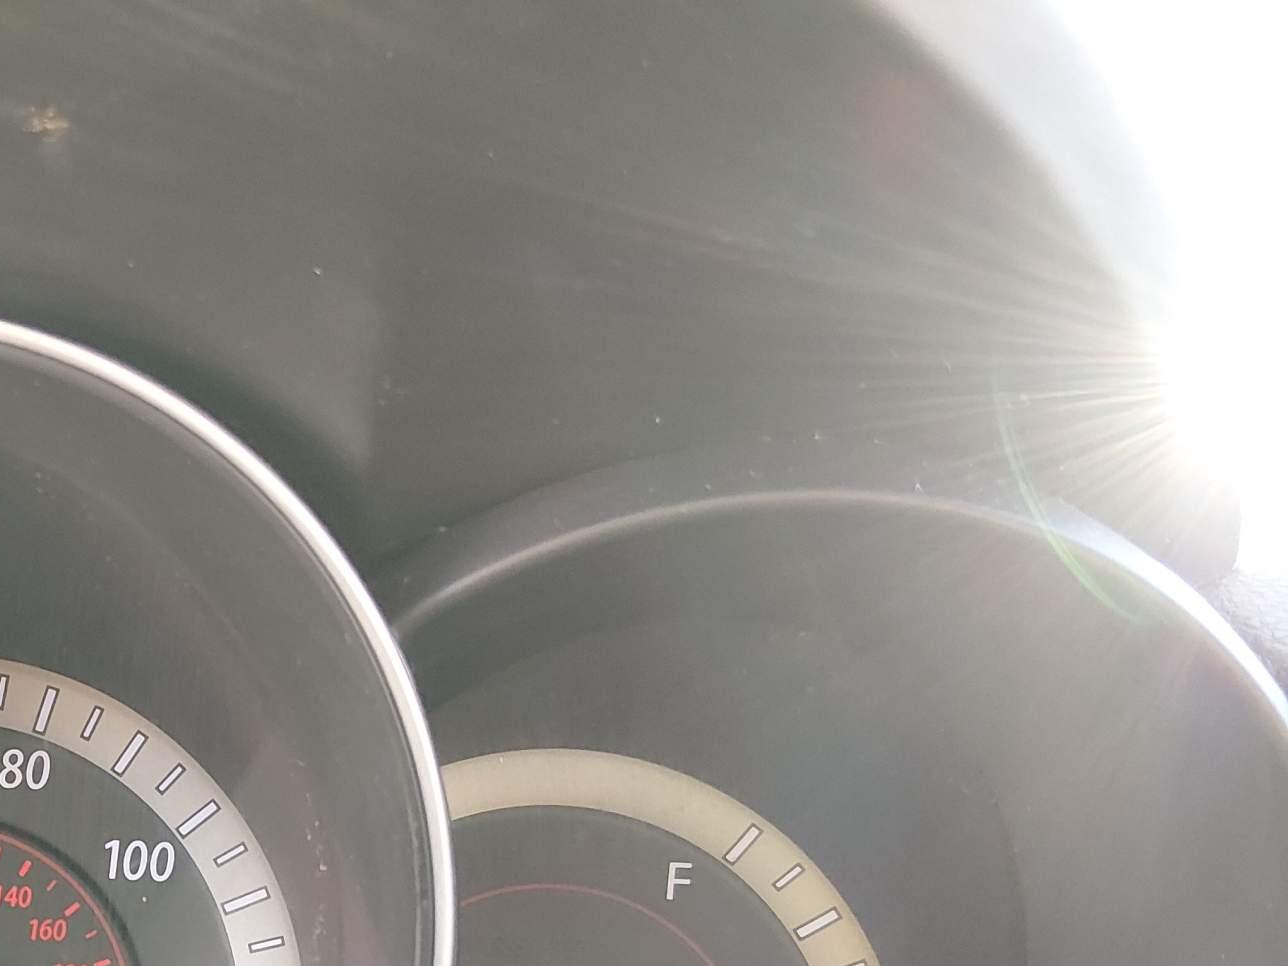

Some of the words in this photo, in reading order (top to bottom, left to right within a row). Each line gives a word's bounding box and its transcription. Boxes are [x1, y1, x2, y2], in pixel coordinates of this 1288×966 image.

[104, 840, 175, 882] 100
[666, 862, 693, 900] F
[29, 917, 67, 942] 160
